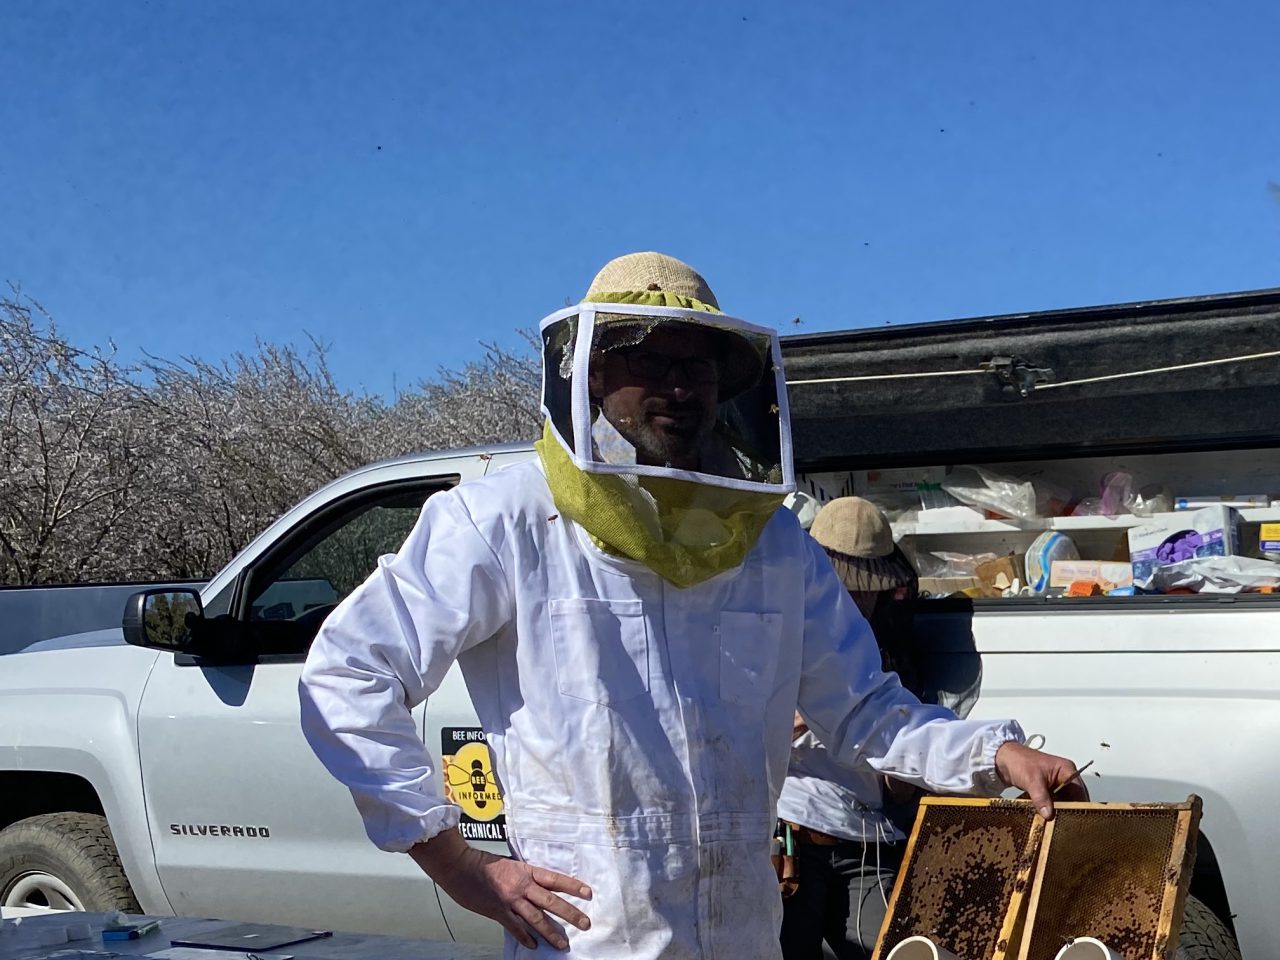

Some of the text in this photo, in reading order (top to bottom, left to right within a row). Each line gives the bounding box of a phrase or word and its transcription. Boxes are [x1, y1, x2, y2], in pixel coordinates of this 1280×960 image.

[452, 730, 487, 741] BEE INFO
[471, 776, 485, 785] BEE
[458, 791, 503, 801] INFORMED
[170, 823, 270, 838] SILVERADO
